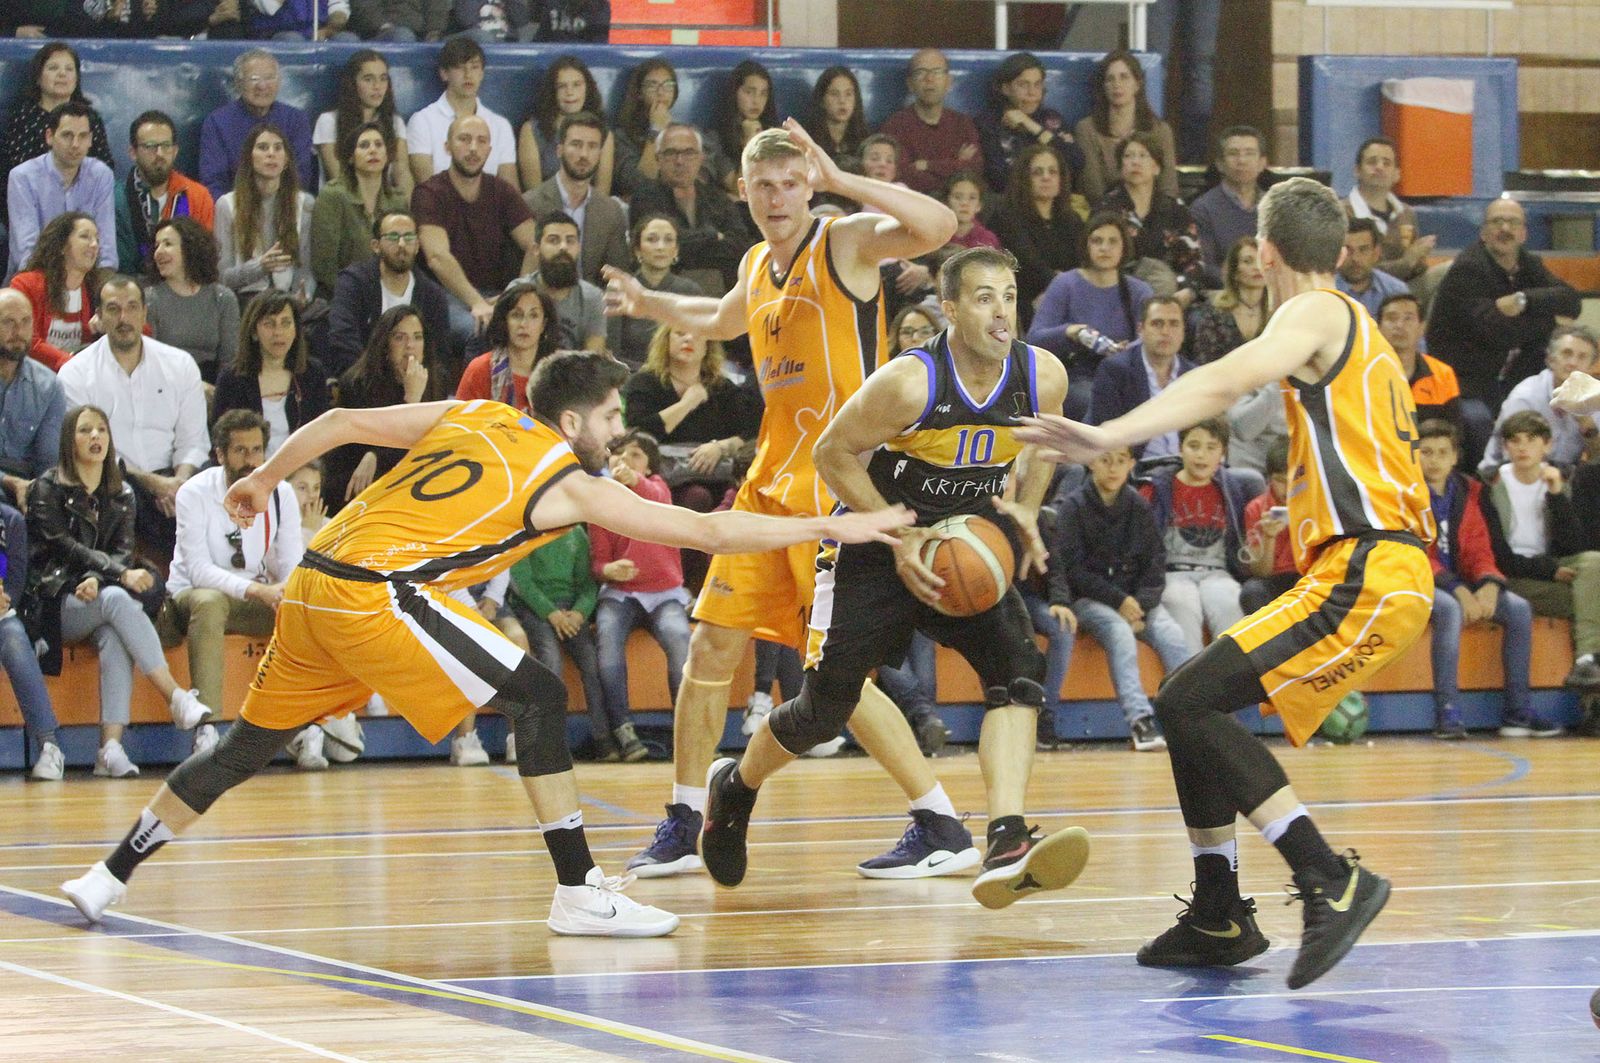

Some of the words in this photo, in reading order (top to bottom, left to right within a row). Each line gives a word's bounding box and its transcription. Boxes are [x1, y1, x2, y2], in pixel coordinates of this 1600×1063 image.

[762, 310, 781, 345] 14
[953, 428, 995, 466] 10
[385, 449, 484, 502] 10
